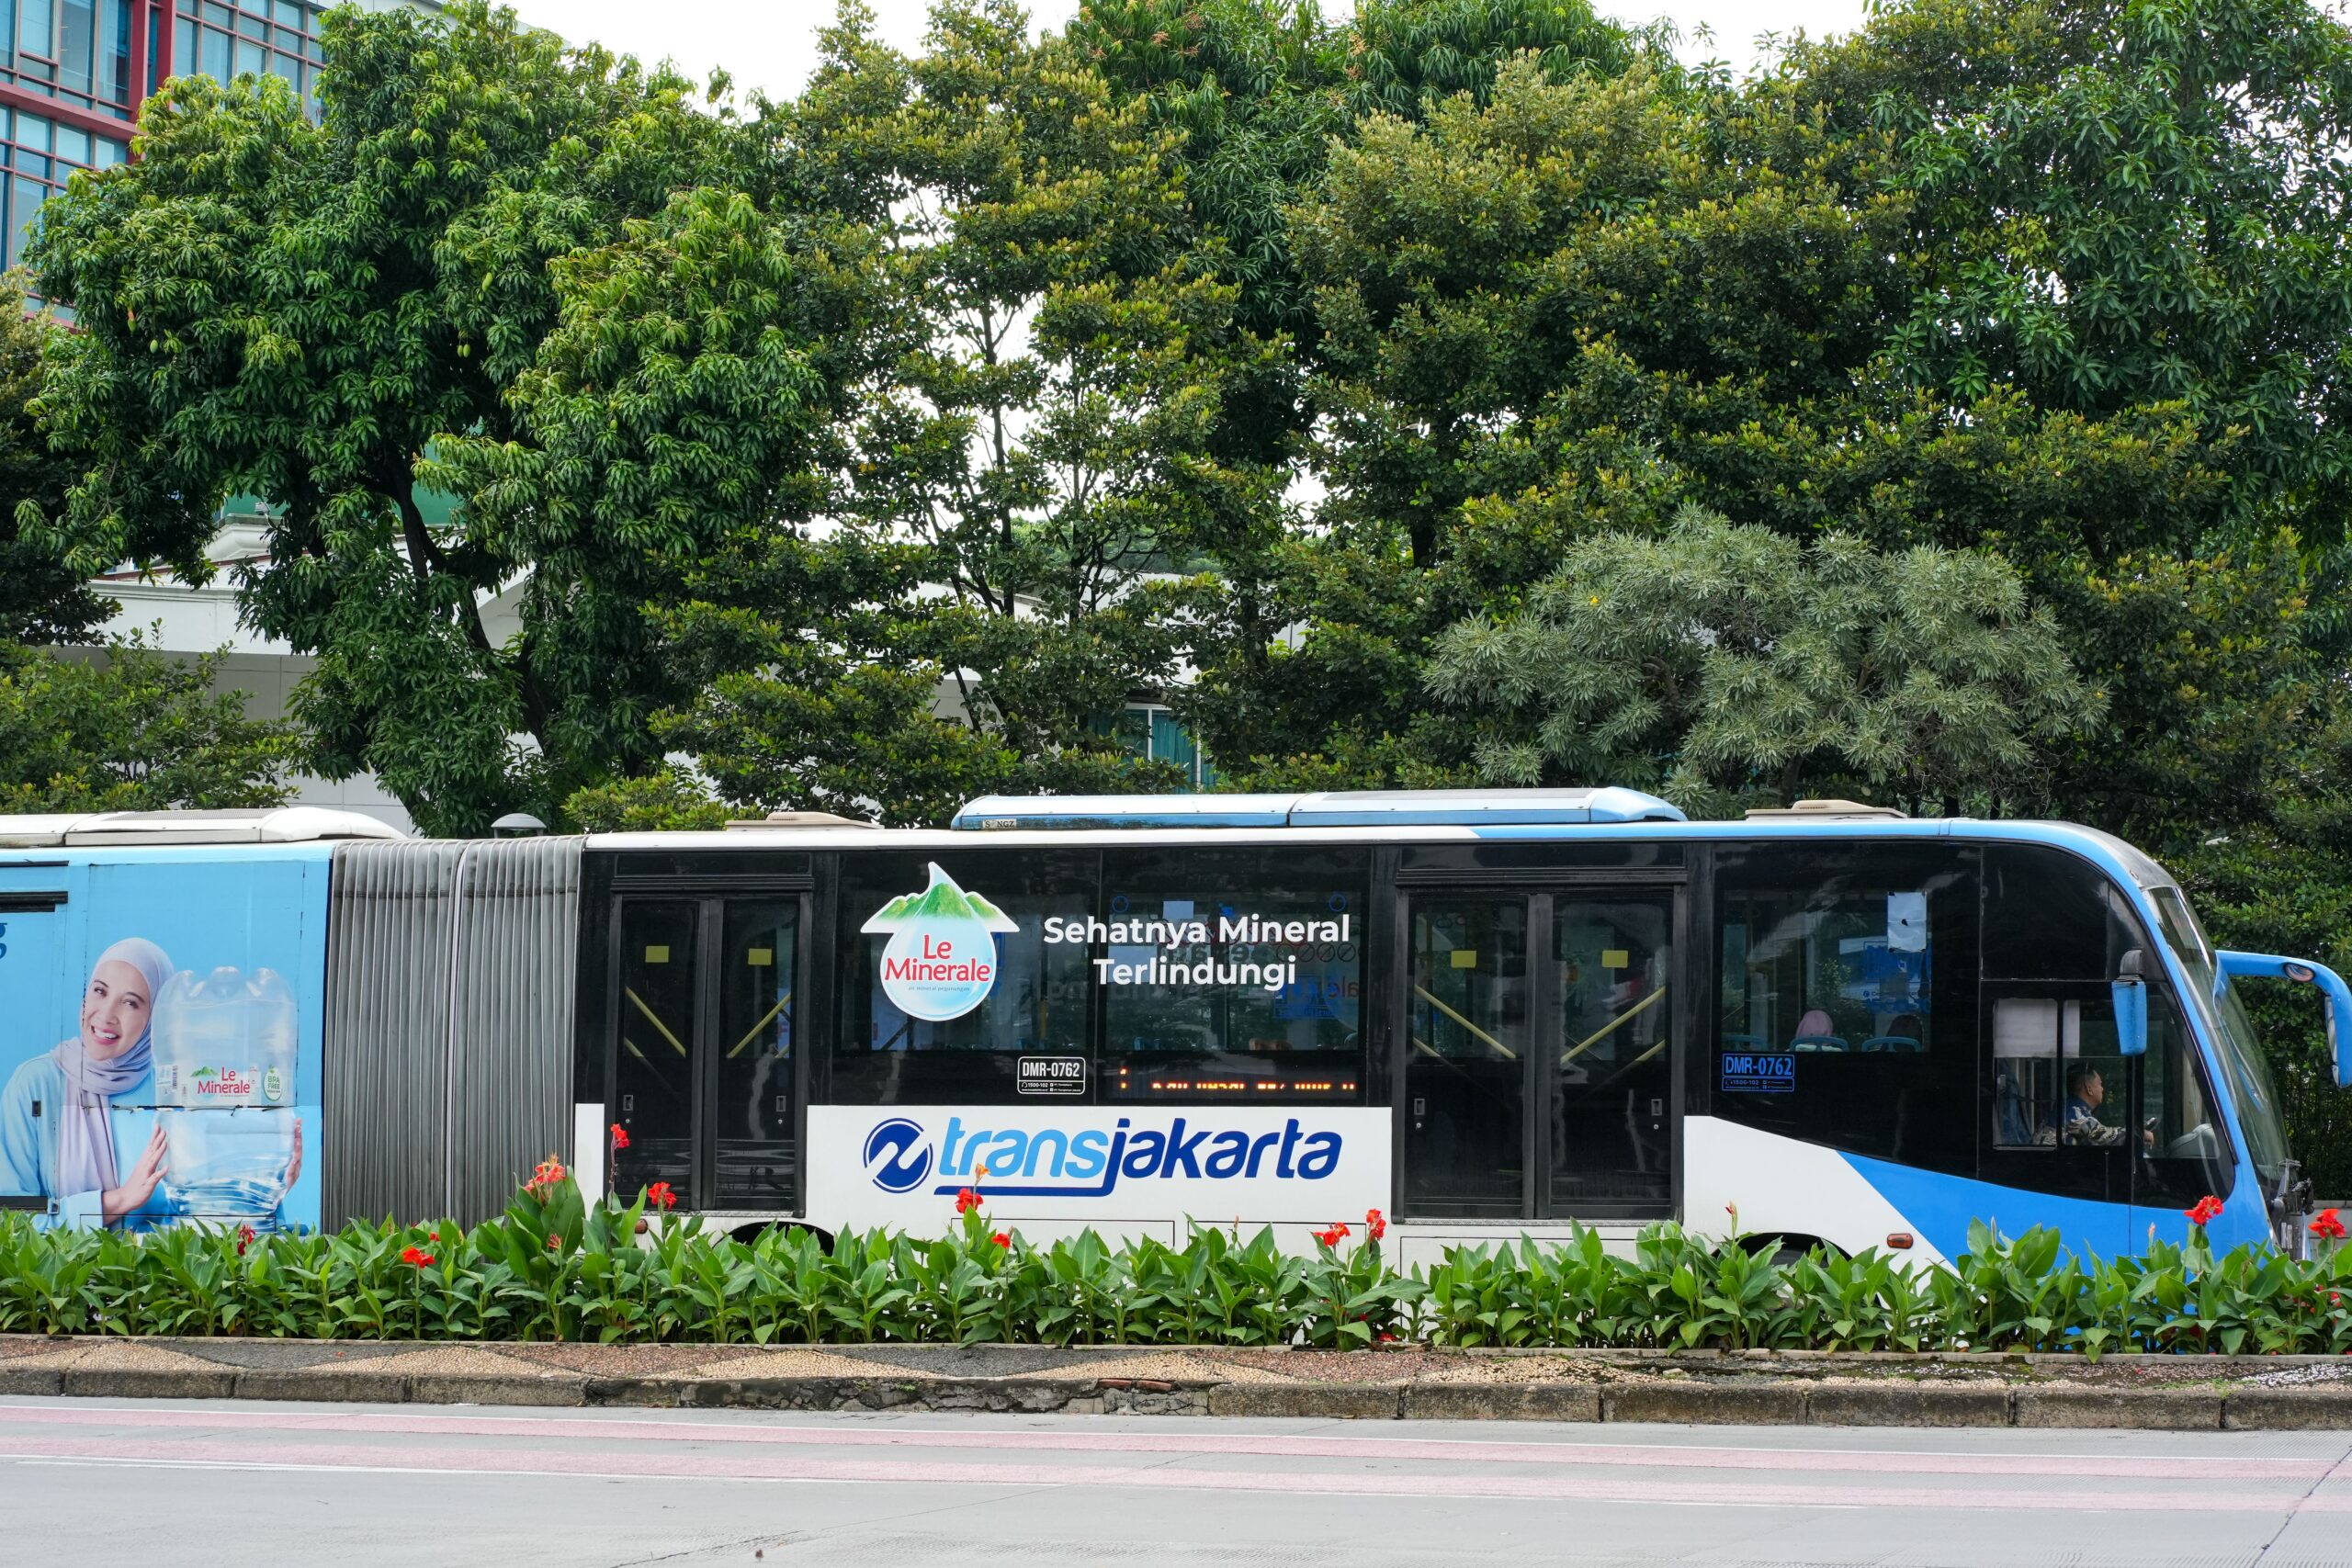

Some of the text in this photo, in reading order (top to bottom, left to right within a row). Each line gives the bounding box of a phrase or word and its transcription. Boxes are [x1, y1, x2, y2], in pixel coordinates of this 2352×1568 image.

[1043, 913, 1350, 950] Sehatnya Mineral
[923, 933, 953, 960] Le
[884, 957, 991, 982] Minerale
[1092, 954, 1296, 991] Terlindungi
[221, 1066, 236, 1081] Le
[1022, 1062, 1080, 1077] DMR-0762
[1725, 1056, 1792, 1076] DMR-0762
[198, 1079, 251, 1094] Minerale
[937, 1117, 1342, 1195] transjakarta
